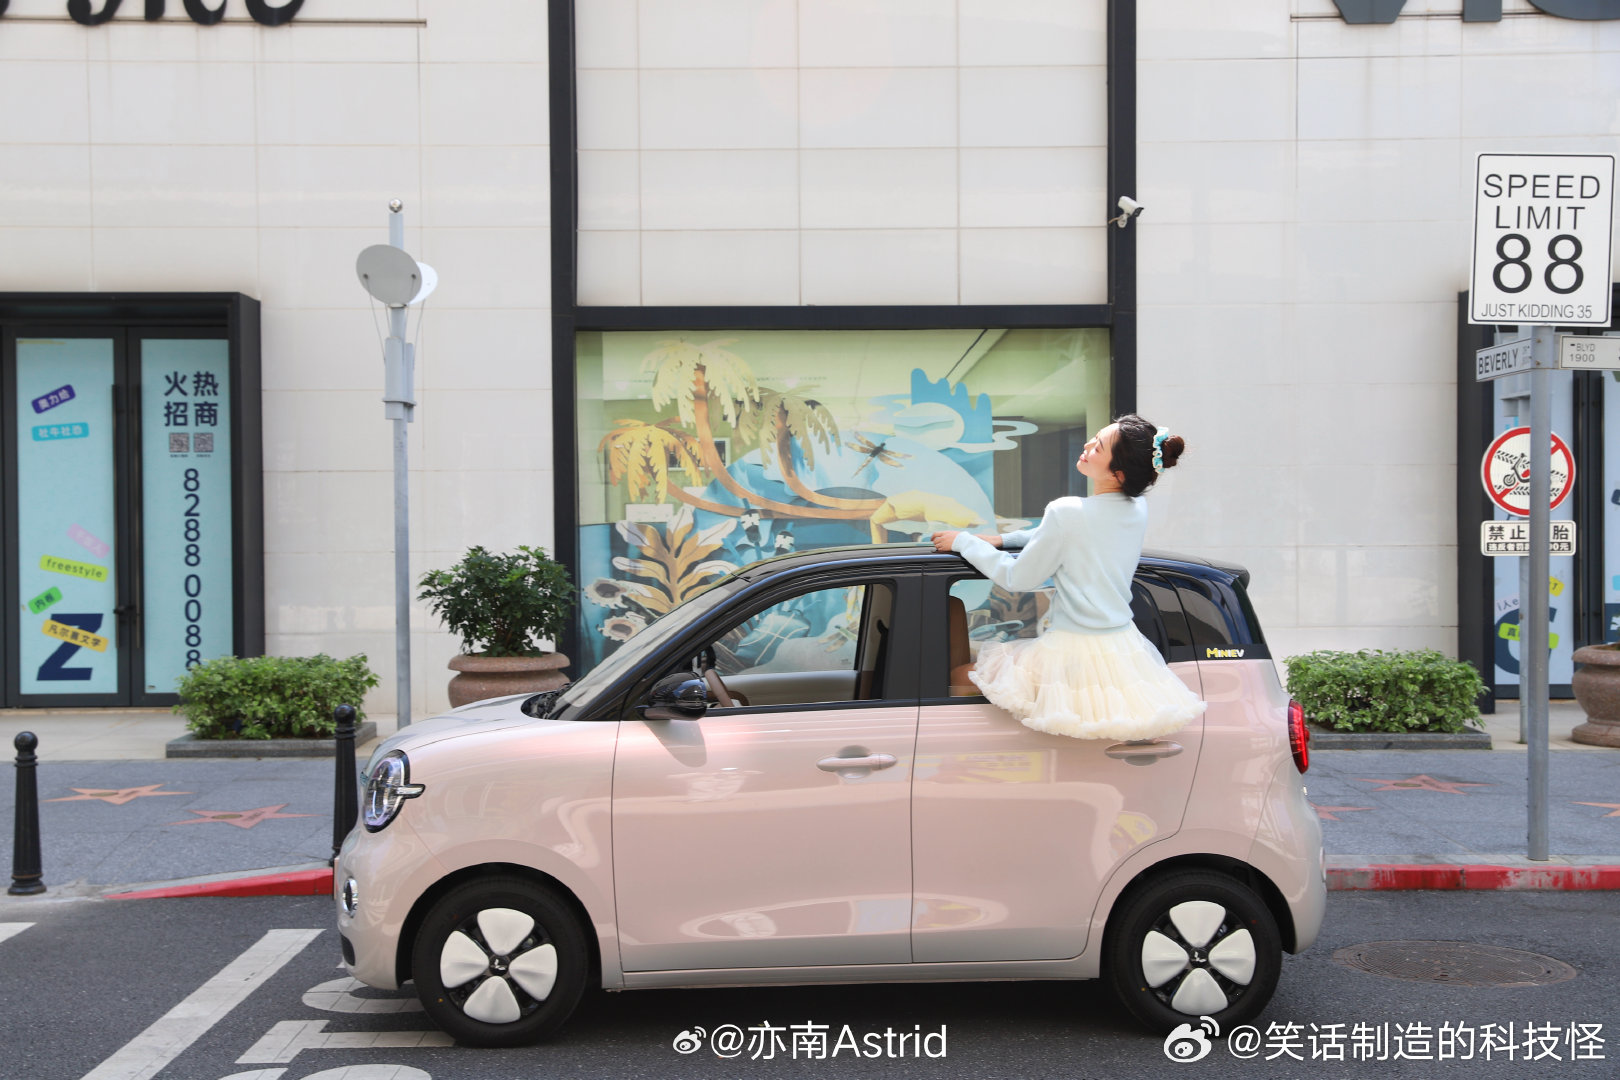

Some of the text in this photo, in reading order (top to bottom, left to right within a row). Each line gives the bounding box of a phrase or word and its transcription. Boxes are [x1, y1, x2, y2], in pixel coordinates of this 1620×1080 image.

[1483, 173, 1600, 199] SPEED
[1495, 205, 1586, 230] LIMIT
[1492, 233, 1584, 295] 88
[1481, 303, 1592, 319] JUST KIDDING 35
[1478, 348, 1519, 375] BEVERLY
[1570, 353, 1595, 362] 1900
[163, 370, 220, 397] 火热
[163, 400, 219, 427] 招商
[1488, 525, 1570, 541] 禁止胎
[46, 558, 103, 578] freestyle
